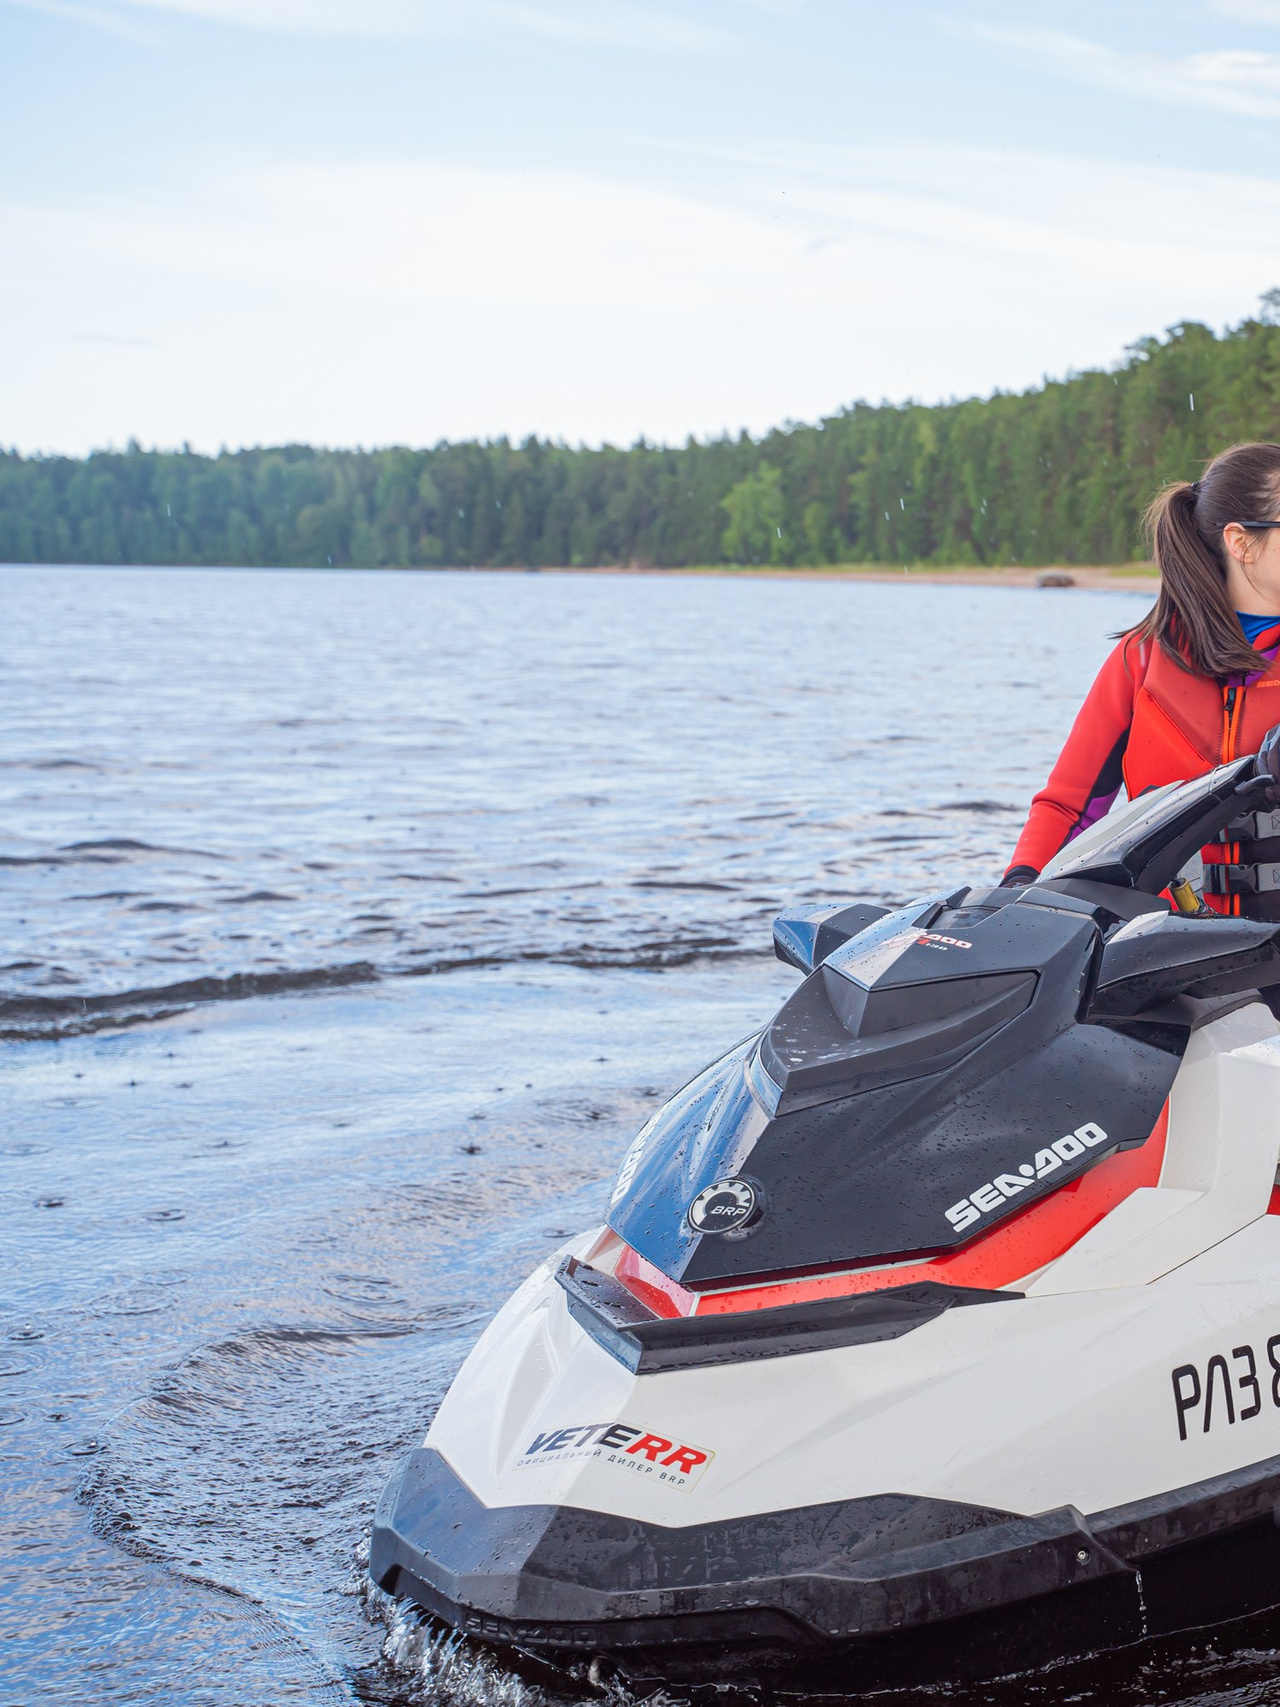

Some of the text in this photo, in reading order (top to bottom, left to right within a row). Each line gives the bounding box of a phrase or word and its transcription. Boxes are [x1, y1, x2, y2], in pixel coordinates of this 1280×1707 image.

[710, 1205, 747, 1216] BRP
[516, 1448, 686, 1486] ОФИЦИАЛЬНЫЙ ДИЛЕР BRP
[525, 1422, 708, 1475] VETERR
